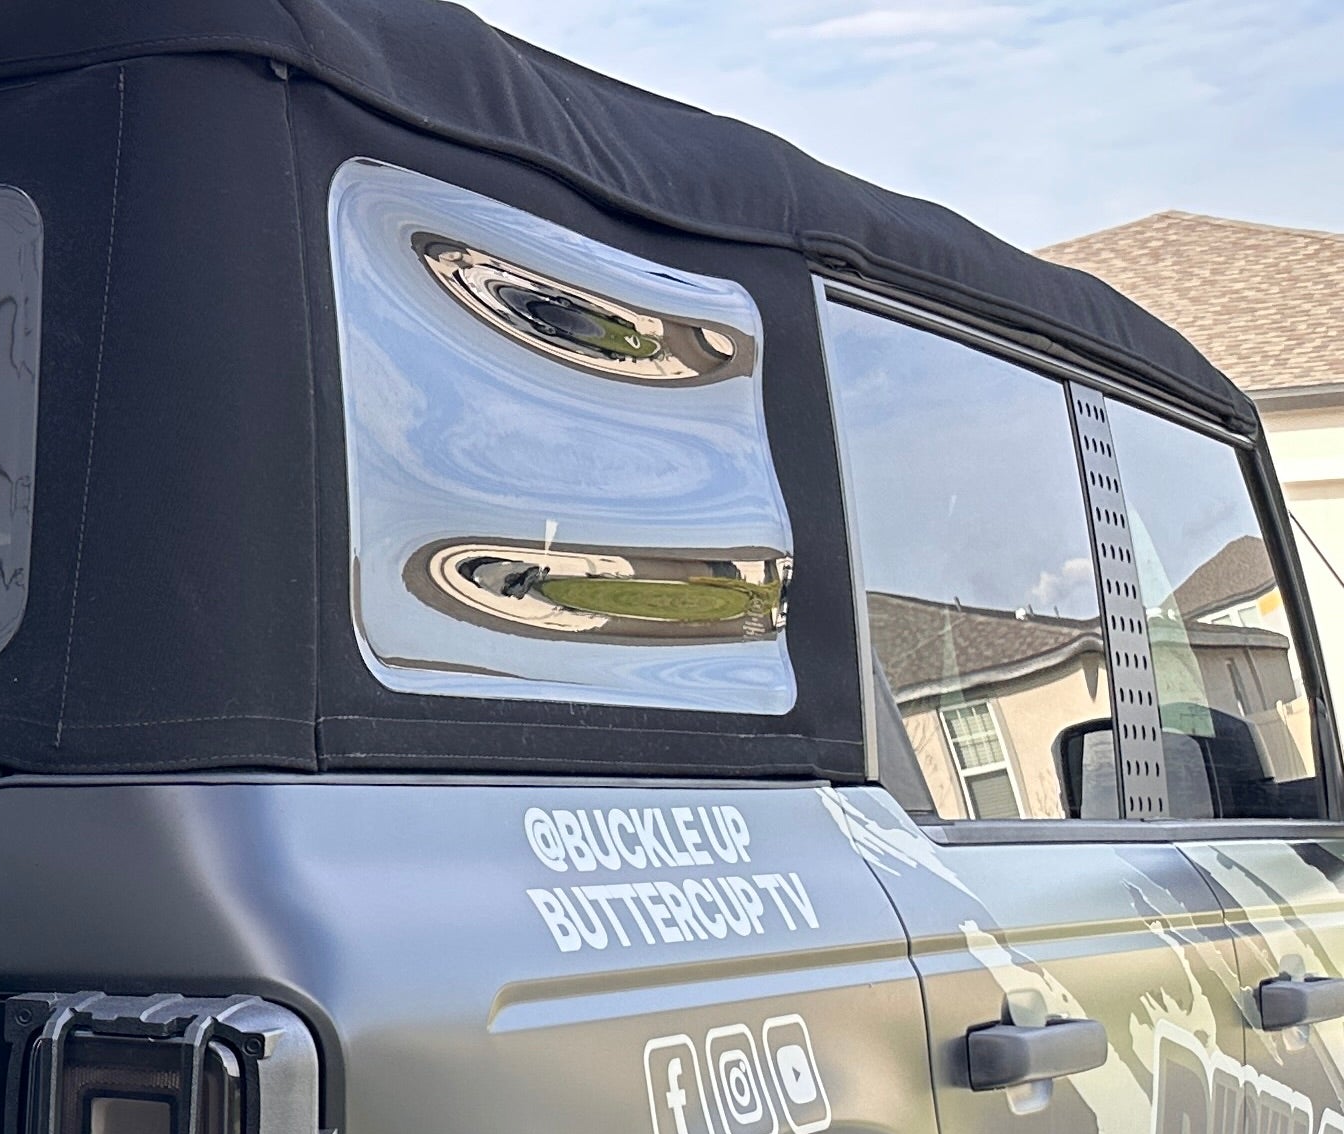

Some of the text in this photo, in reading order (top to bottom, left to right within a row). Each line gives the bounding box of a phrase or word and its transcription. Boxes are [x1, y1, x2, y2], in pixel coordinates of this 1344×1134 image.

[524, 806, 751, 872] @BUCKLE UP
[526, 873, 819, 953] BUTTERCUP TV
